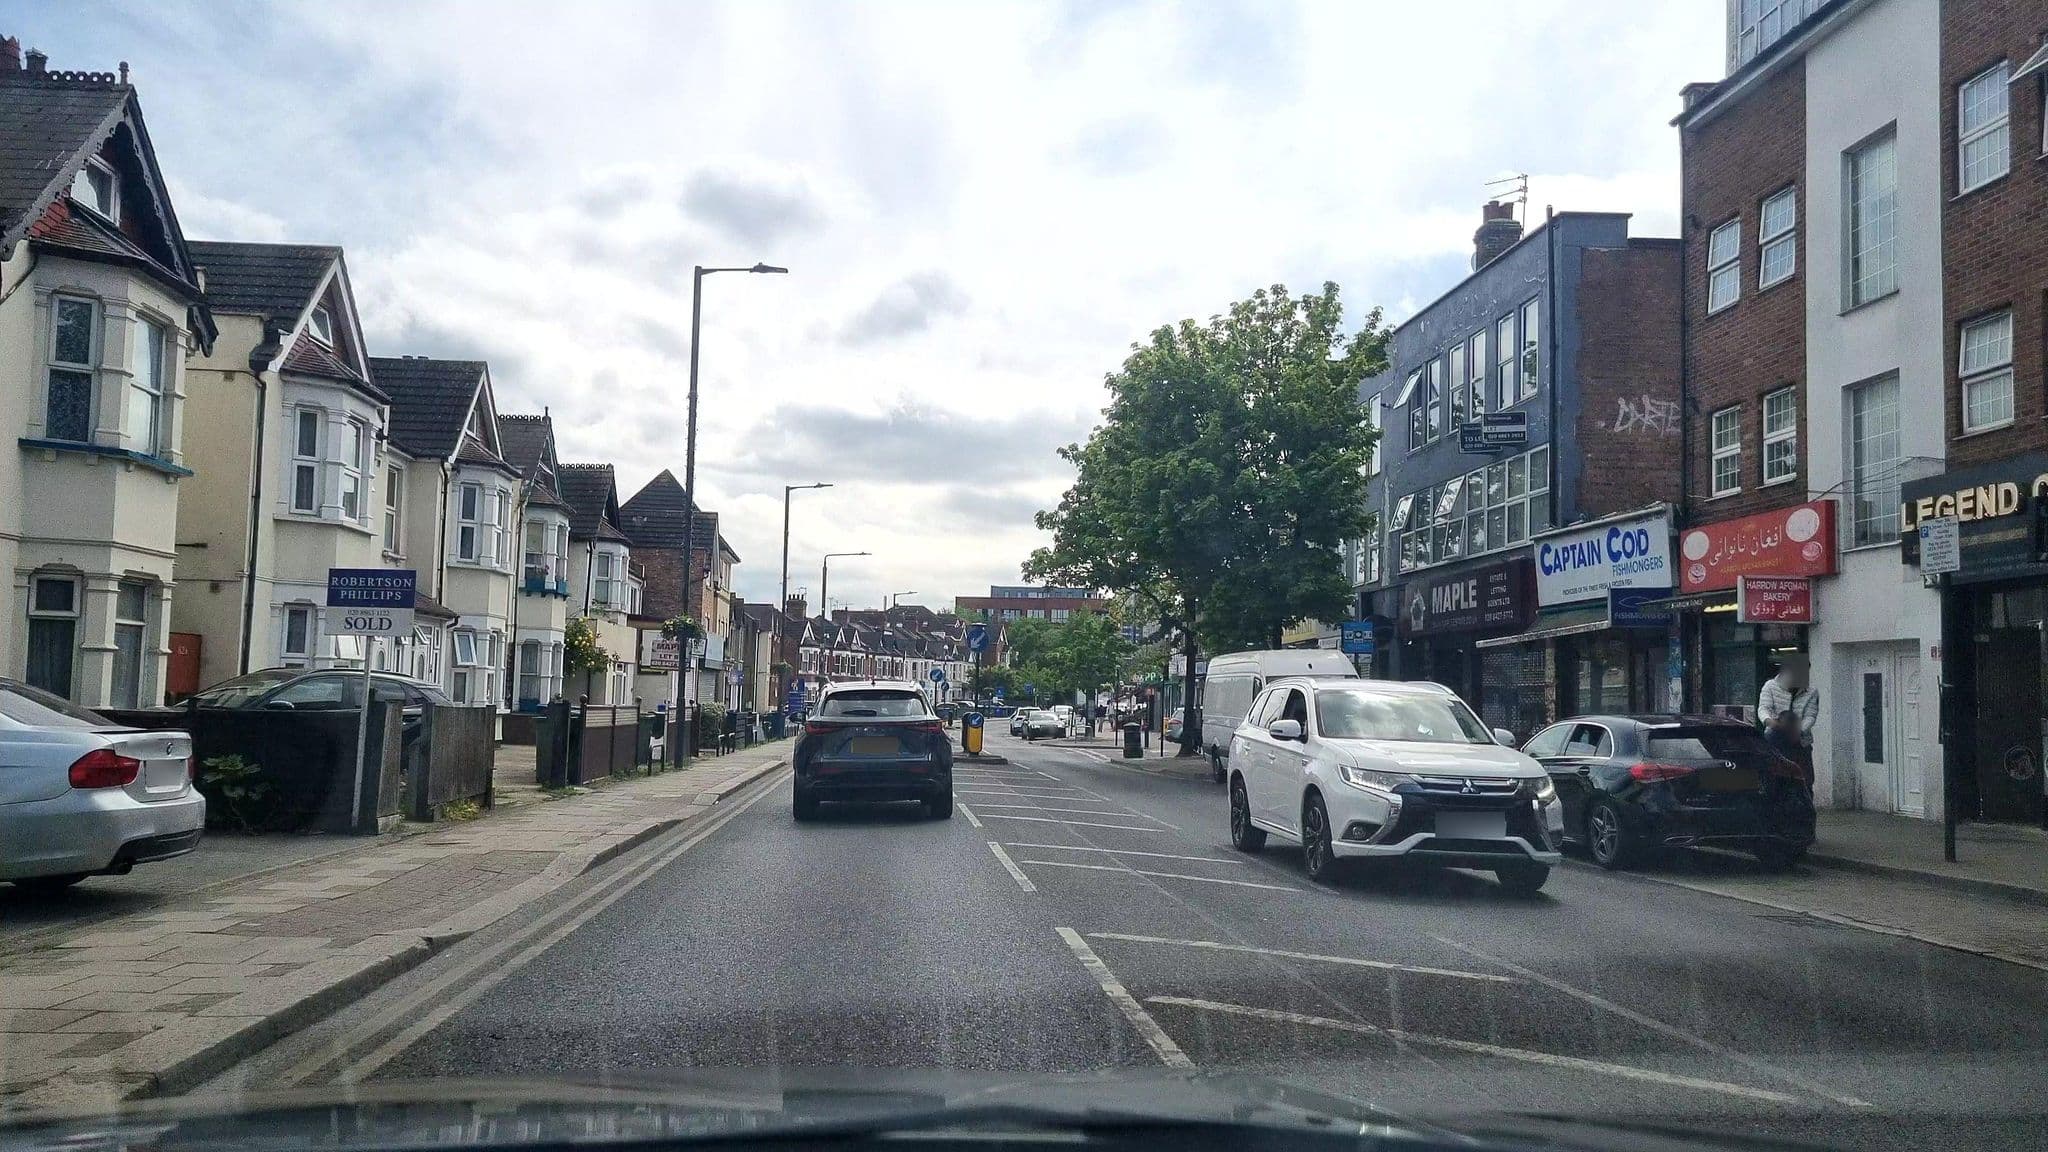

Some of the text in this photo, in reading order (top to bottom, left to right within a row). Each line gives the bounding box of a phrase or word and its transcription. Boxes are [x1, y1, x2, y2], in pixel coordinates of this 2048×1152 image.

[1901, 482, 2018, 533] LEGEND
[1612, 556, 1664, 577] FISHMONGERS
[331, 577, 412, 588] ROBERTSON
[1746, 580, 1777, 590] HARROW
[340, 590, 402, 601] PHILLIPS
[1432, 579, 1477, 615] MAPLE
[1763, 592, 1791, 601] BAKERY
[344, 616, 393, 631] SOLD
